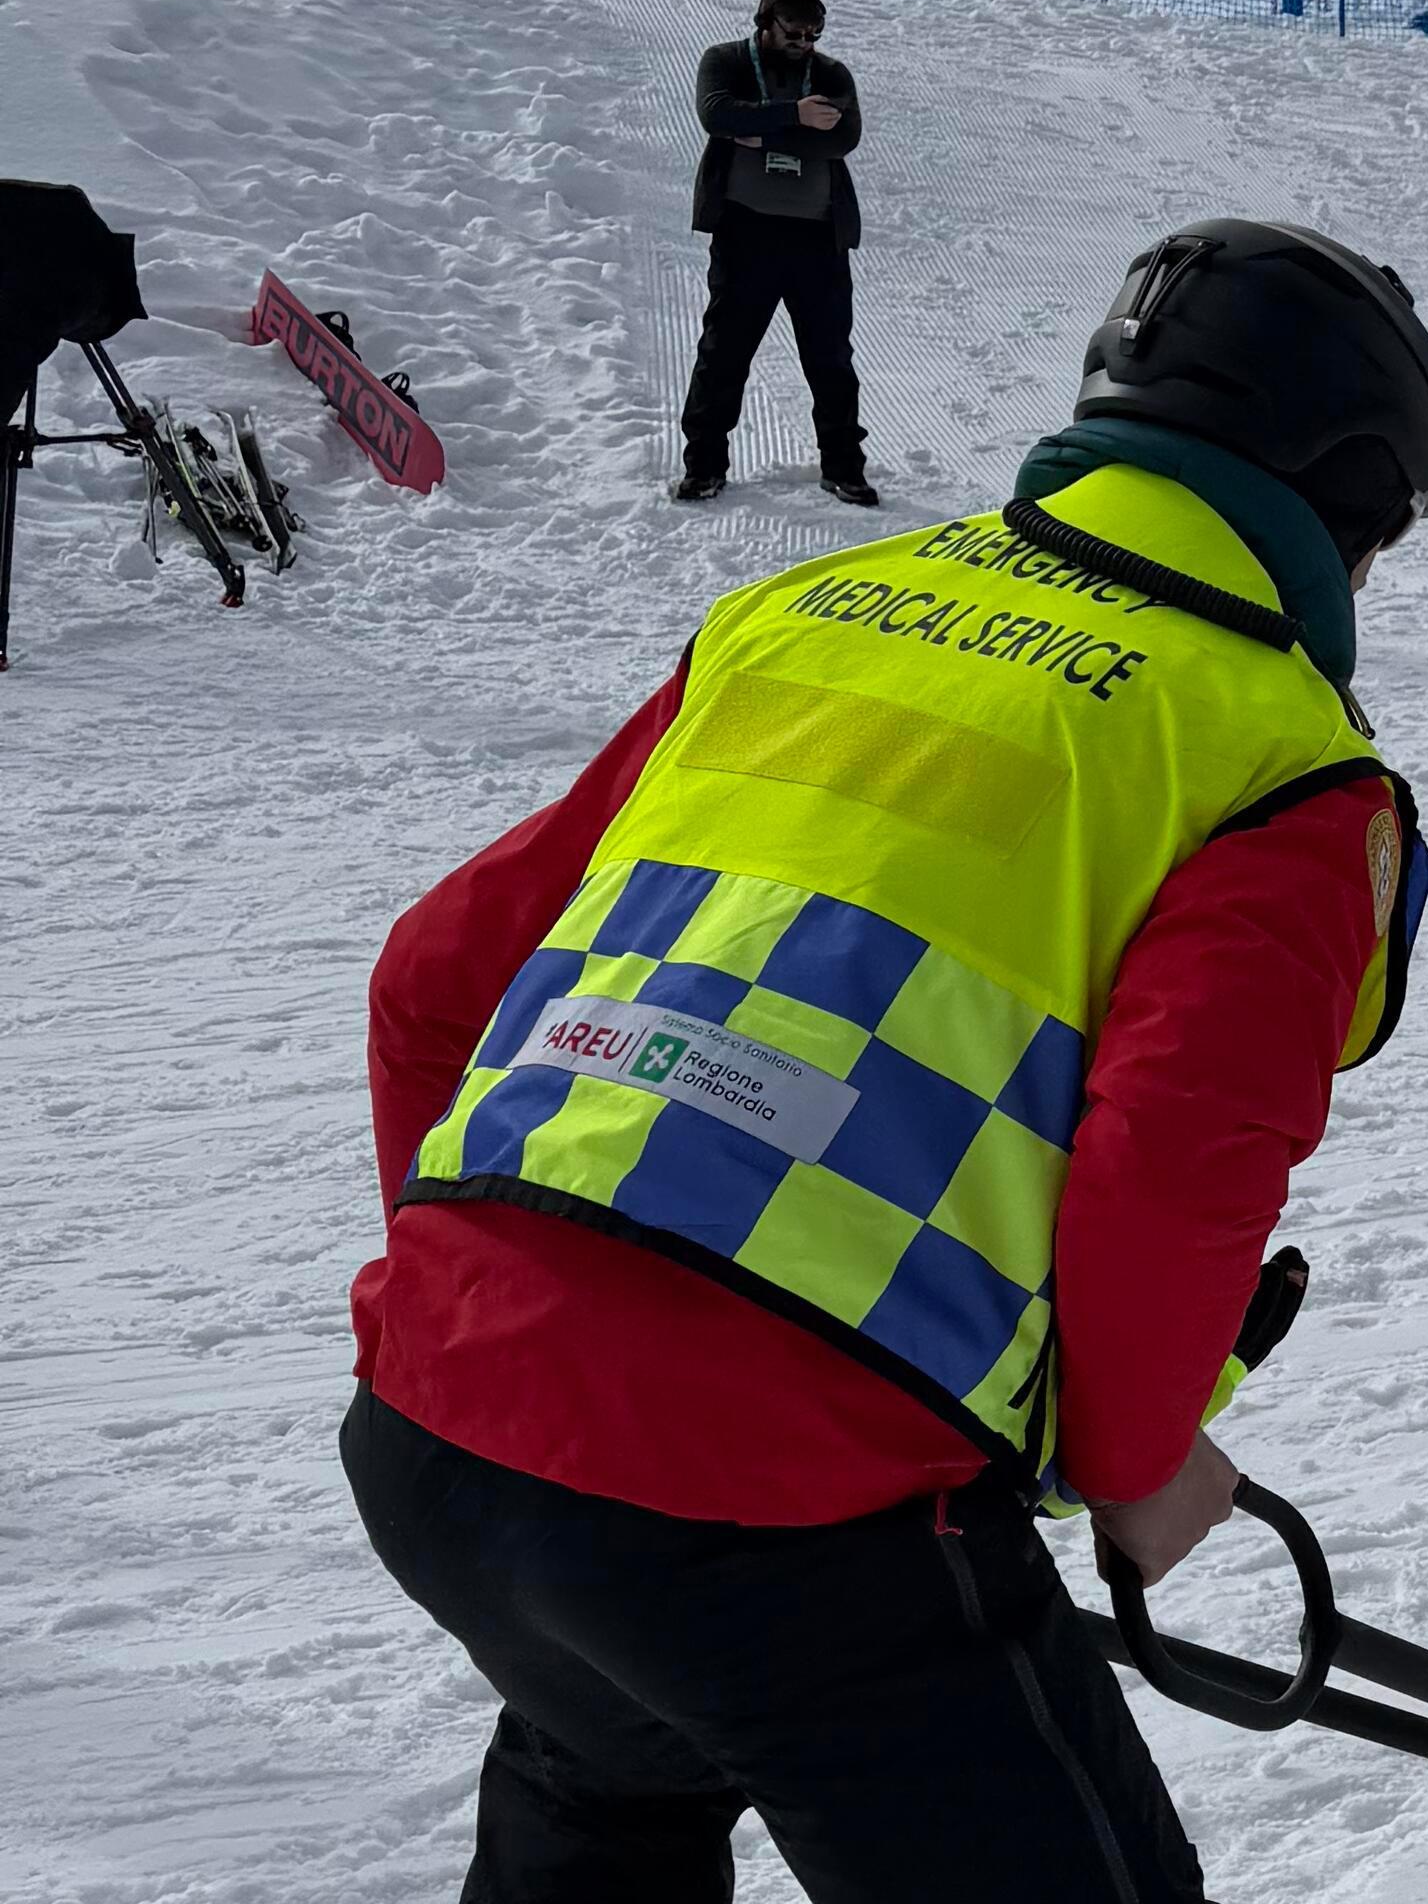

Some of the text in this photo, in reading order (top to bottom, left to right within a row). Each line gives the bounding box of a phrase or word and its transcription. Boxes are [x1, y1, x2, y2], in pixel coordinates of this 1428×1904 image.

[261, 298, 410, 466] BURTON
[783, 576, 1149, 702] MEDICAL SERVICE
[543, 1018, 634, 1061] AREU
[672, 1066, 778, 1122] Lombardia
[682, 1049, 765, 1094] Regione
